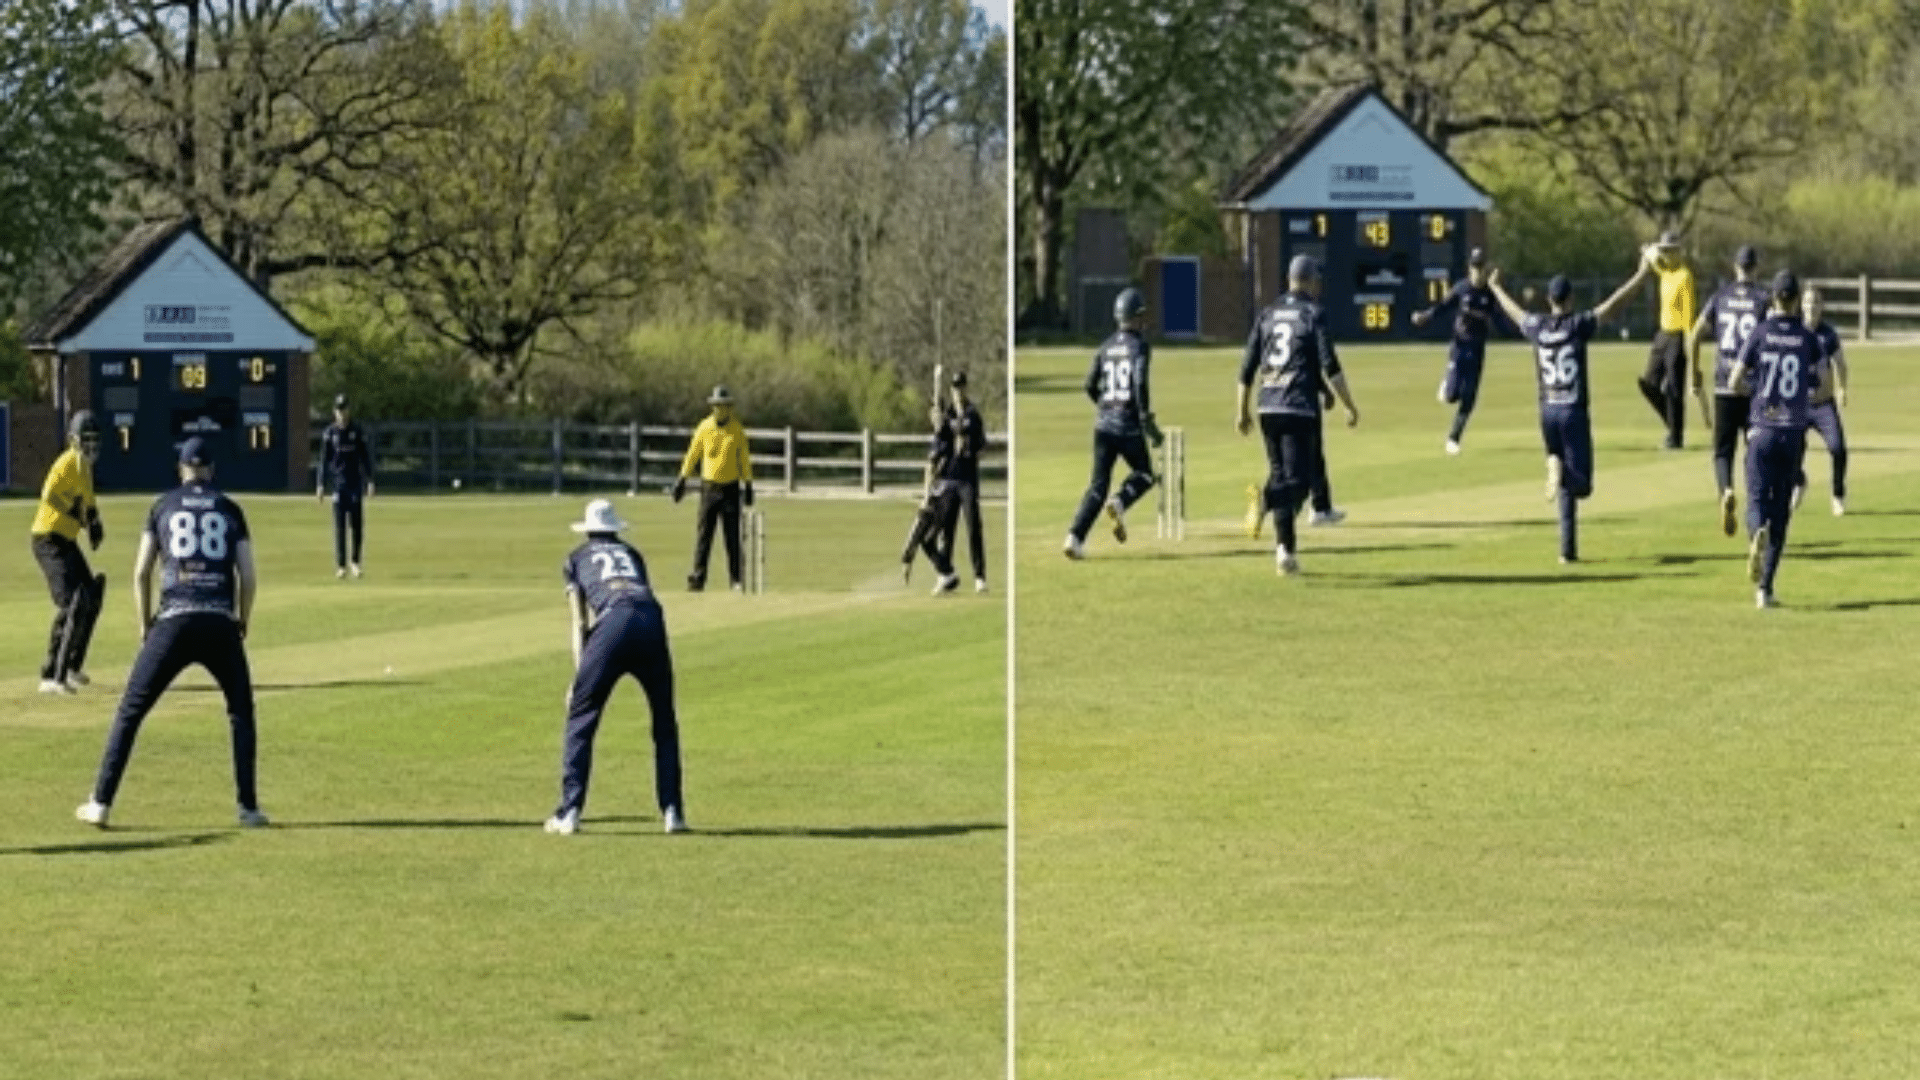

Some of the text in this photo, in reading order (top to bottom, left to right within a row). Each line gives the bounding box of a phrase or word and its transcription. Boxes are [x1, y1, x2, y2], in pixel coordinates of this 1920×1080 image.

[1268, 323, 1292, 366] 3
[1539, 344, 1578, 385] 56
[1760, 351, 1799, 398] 78
[168, 511, 228, 559] 88
[590, 550, 638, 580] 23
